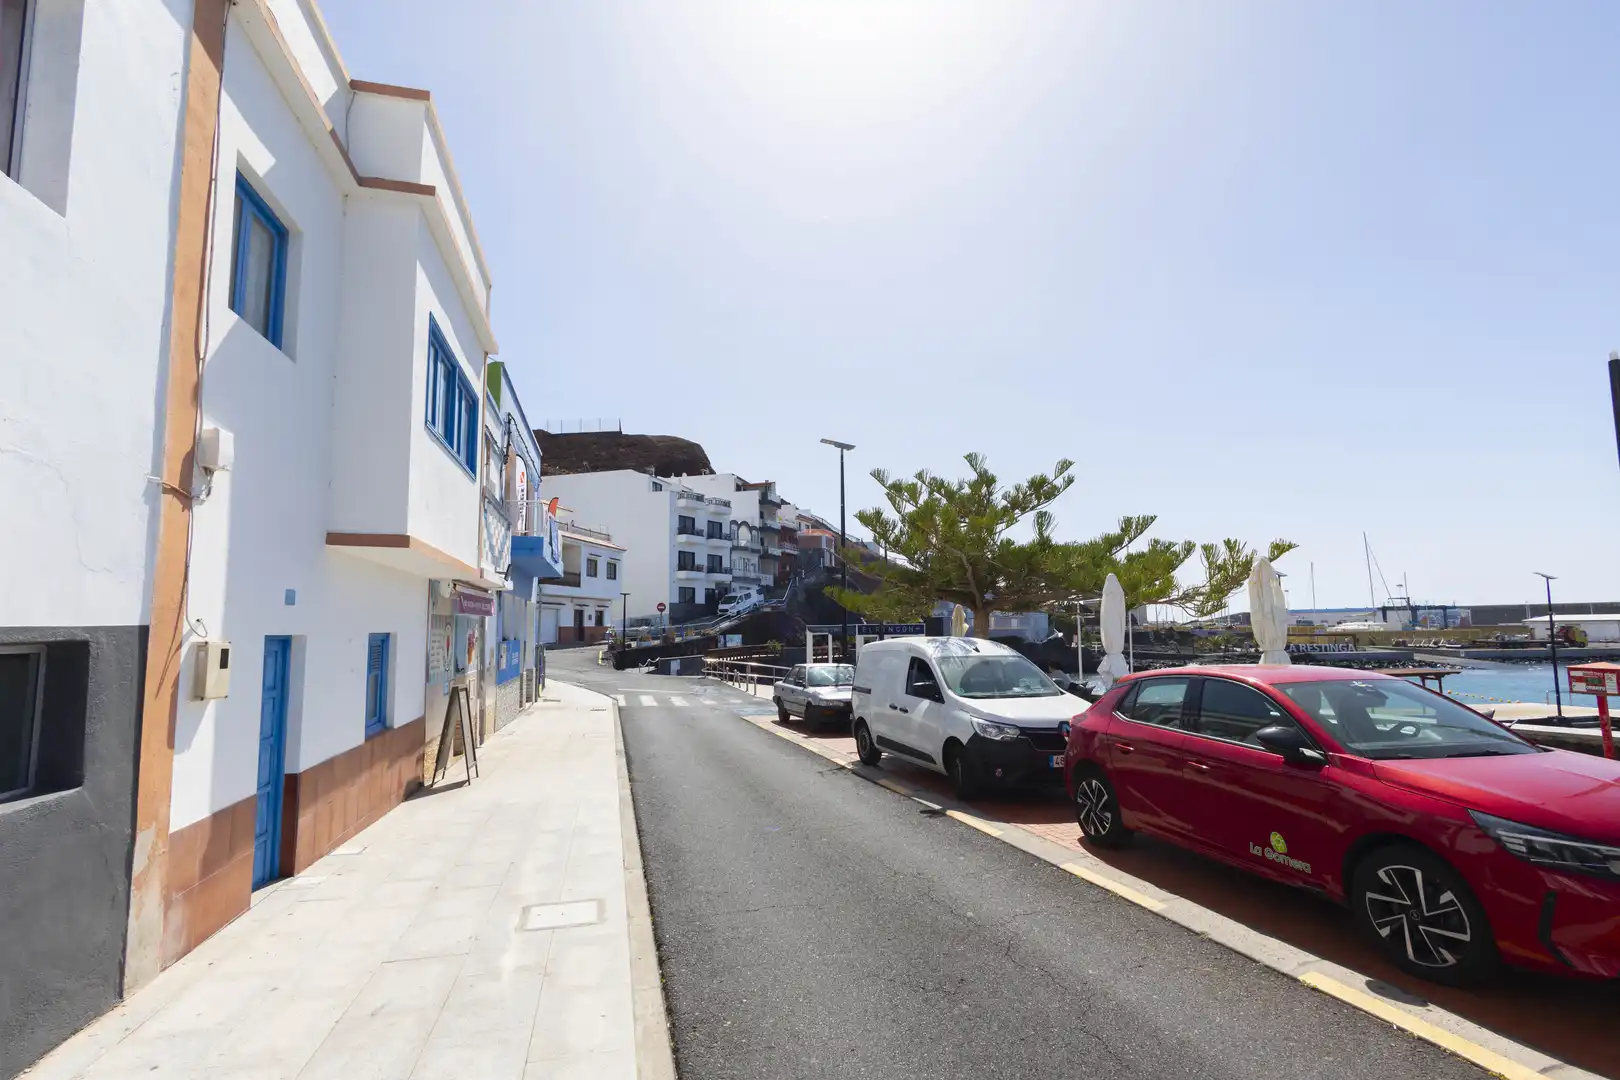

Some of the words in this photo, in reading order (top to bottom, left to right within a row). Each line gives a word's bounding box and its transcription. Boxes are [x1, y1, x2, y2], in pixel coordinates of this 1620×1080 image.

[1299, 643, 1356, 653] RESTINGA
[1249, 841, 1263, 857] La
[1264, 847, 1312, 874] Gomera
